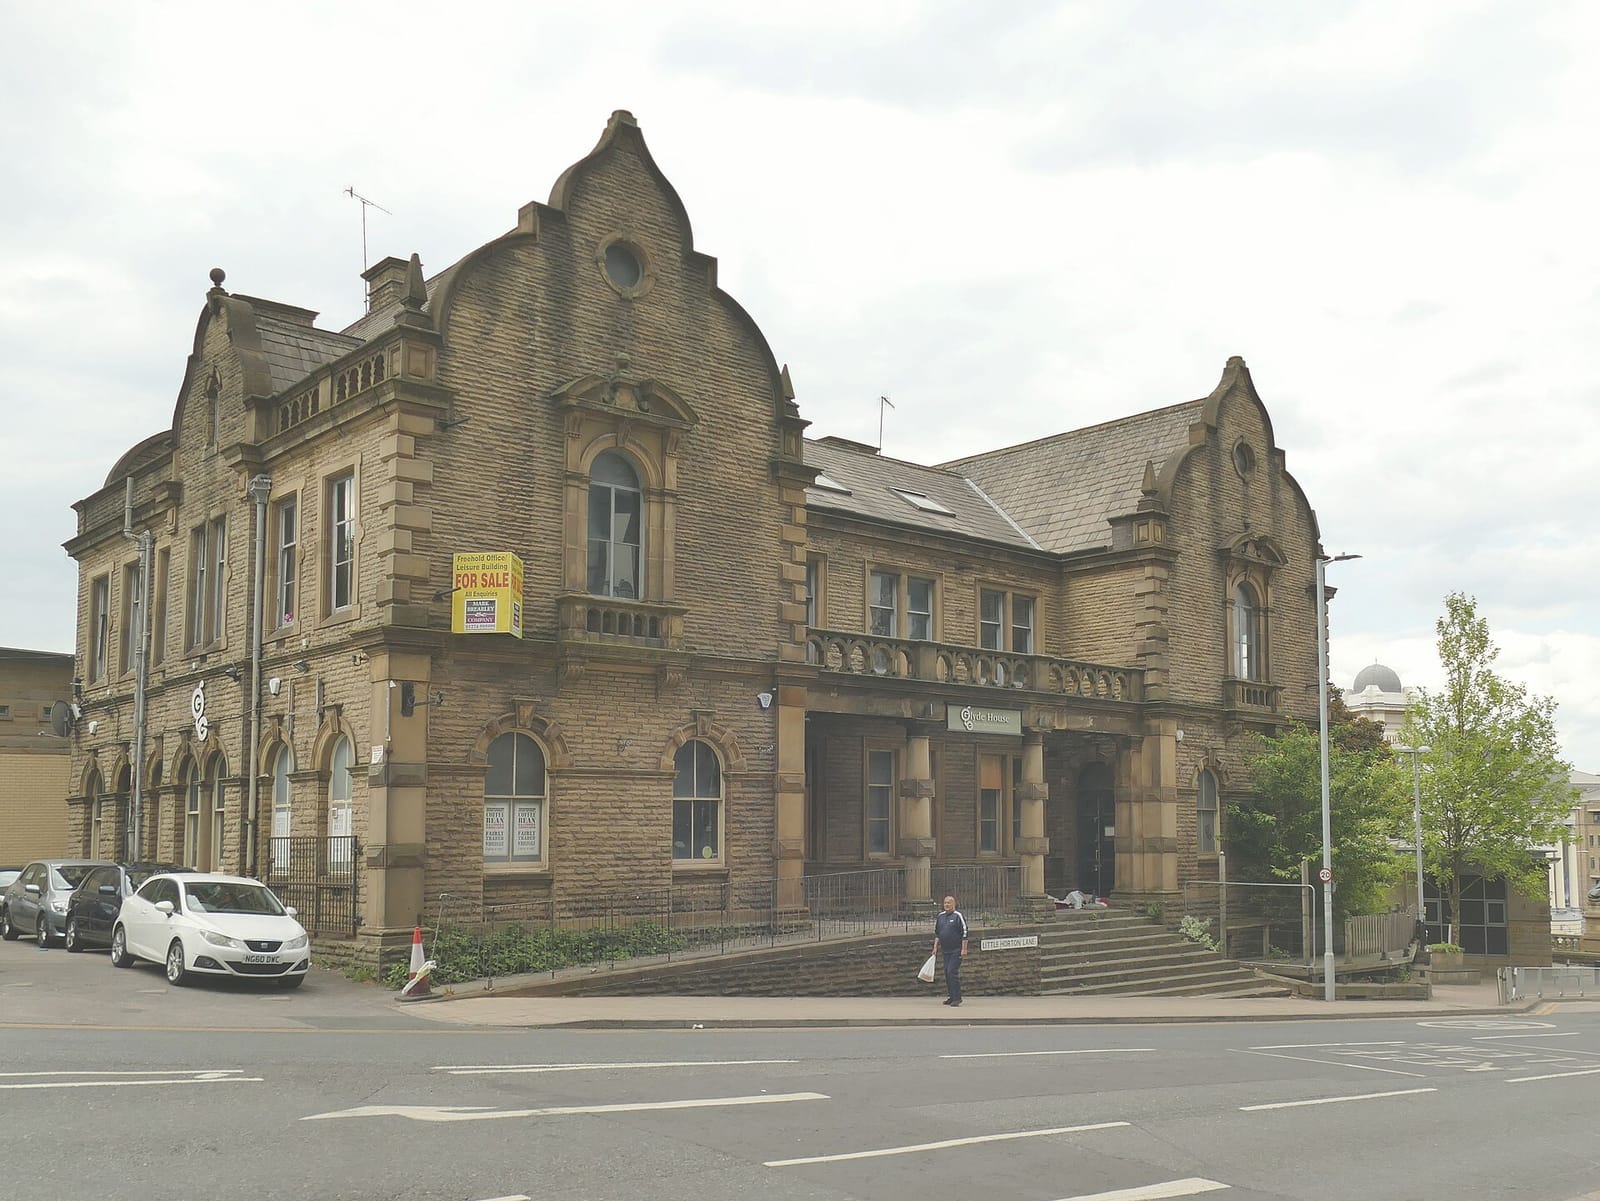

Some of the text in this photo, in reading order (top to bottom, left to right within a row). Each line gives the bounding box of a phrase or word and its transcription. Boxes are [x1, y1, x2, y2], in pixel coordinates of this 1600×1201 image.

[481, 563, 508, 571] Building
[455, 572, 509, 589] FOR SALE
[961, 706, 1009, 723] Glyde House
[982, 937, 1037, 949] LITTLE HORTON LANE
[245, 955, 265, 963] NG60
